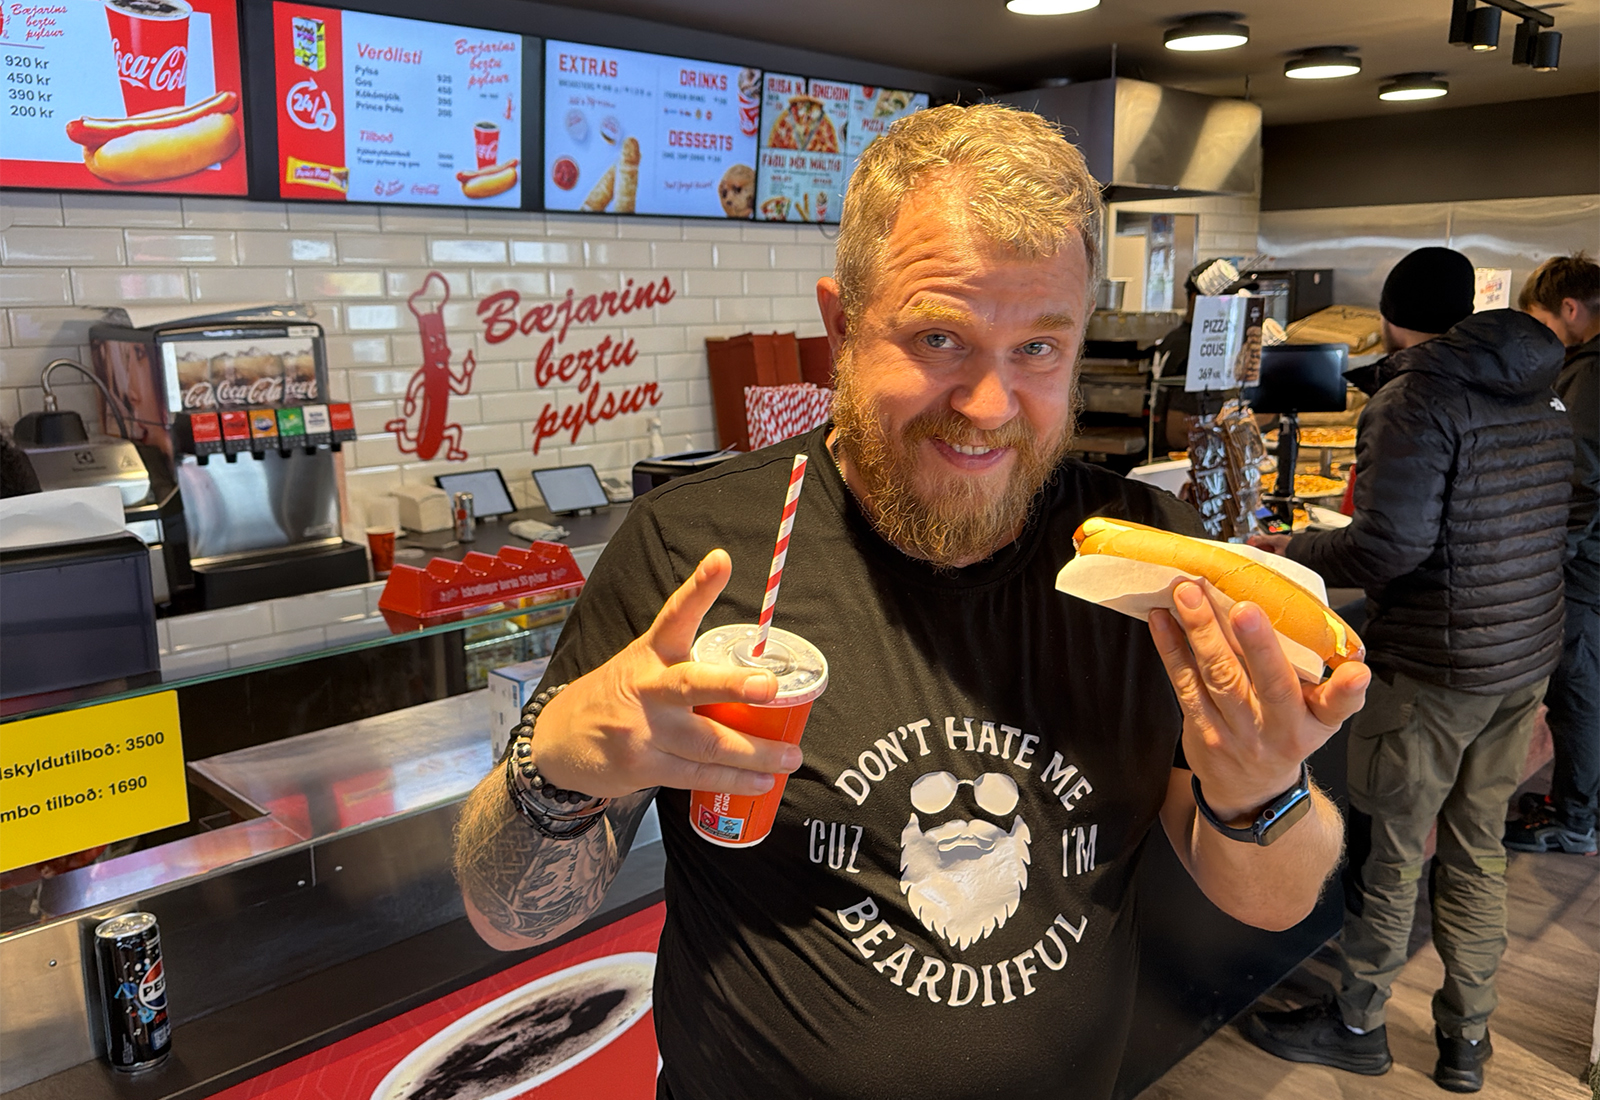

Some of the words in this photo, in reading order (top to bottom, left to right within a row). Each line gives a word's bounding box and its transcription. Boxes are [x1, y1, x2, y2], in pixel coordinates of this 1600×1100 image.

[10, 3, 68, 17] Bæjarins
[26, 15, 57, 29] beztu
[26, 27, 64, 41] pylsur
[5, 55, 31, 68] 920
[34, 57, 49, 69] kr
[357, 42, 422, 65] Verðlisti
[559, 54, 618, 78] EXTRAS
[7, 73, 32, 85] 450
[36, 75, 51, 86] kr
[680, 69, 728, 90] DRINKS
[8, 89, 34, 101] 390
[38, 91, 53, 102] kr
[10, 105, 36, 117] 200
[40, 108, 54, 118] kr
[669, 129, 733, 151] DESSERTS
[476, 275, 676, 344] Bæjarins
[534, 335, 638, 394] beztu
[532, 381, 663, 456] pylsur
[125, 731, 165, 752] 3500
[834, 718, 931, 805] DON'T
[944, 716, 1040, 769] HATE
[1040, 751, 1093, 812] ME
[45, 789, 103, 811] tilboð:
[108, 775, 148, 796] 1690
[803, 818, 863, 874] 'CUZ
[1061, 824, 1098, 877] I'M
